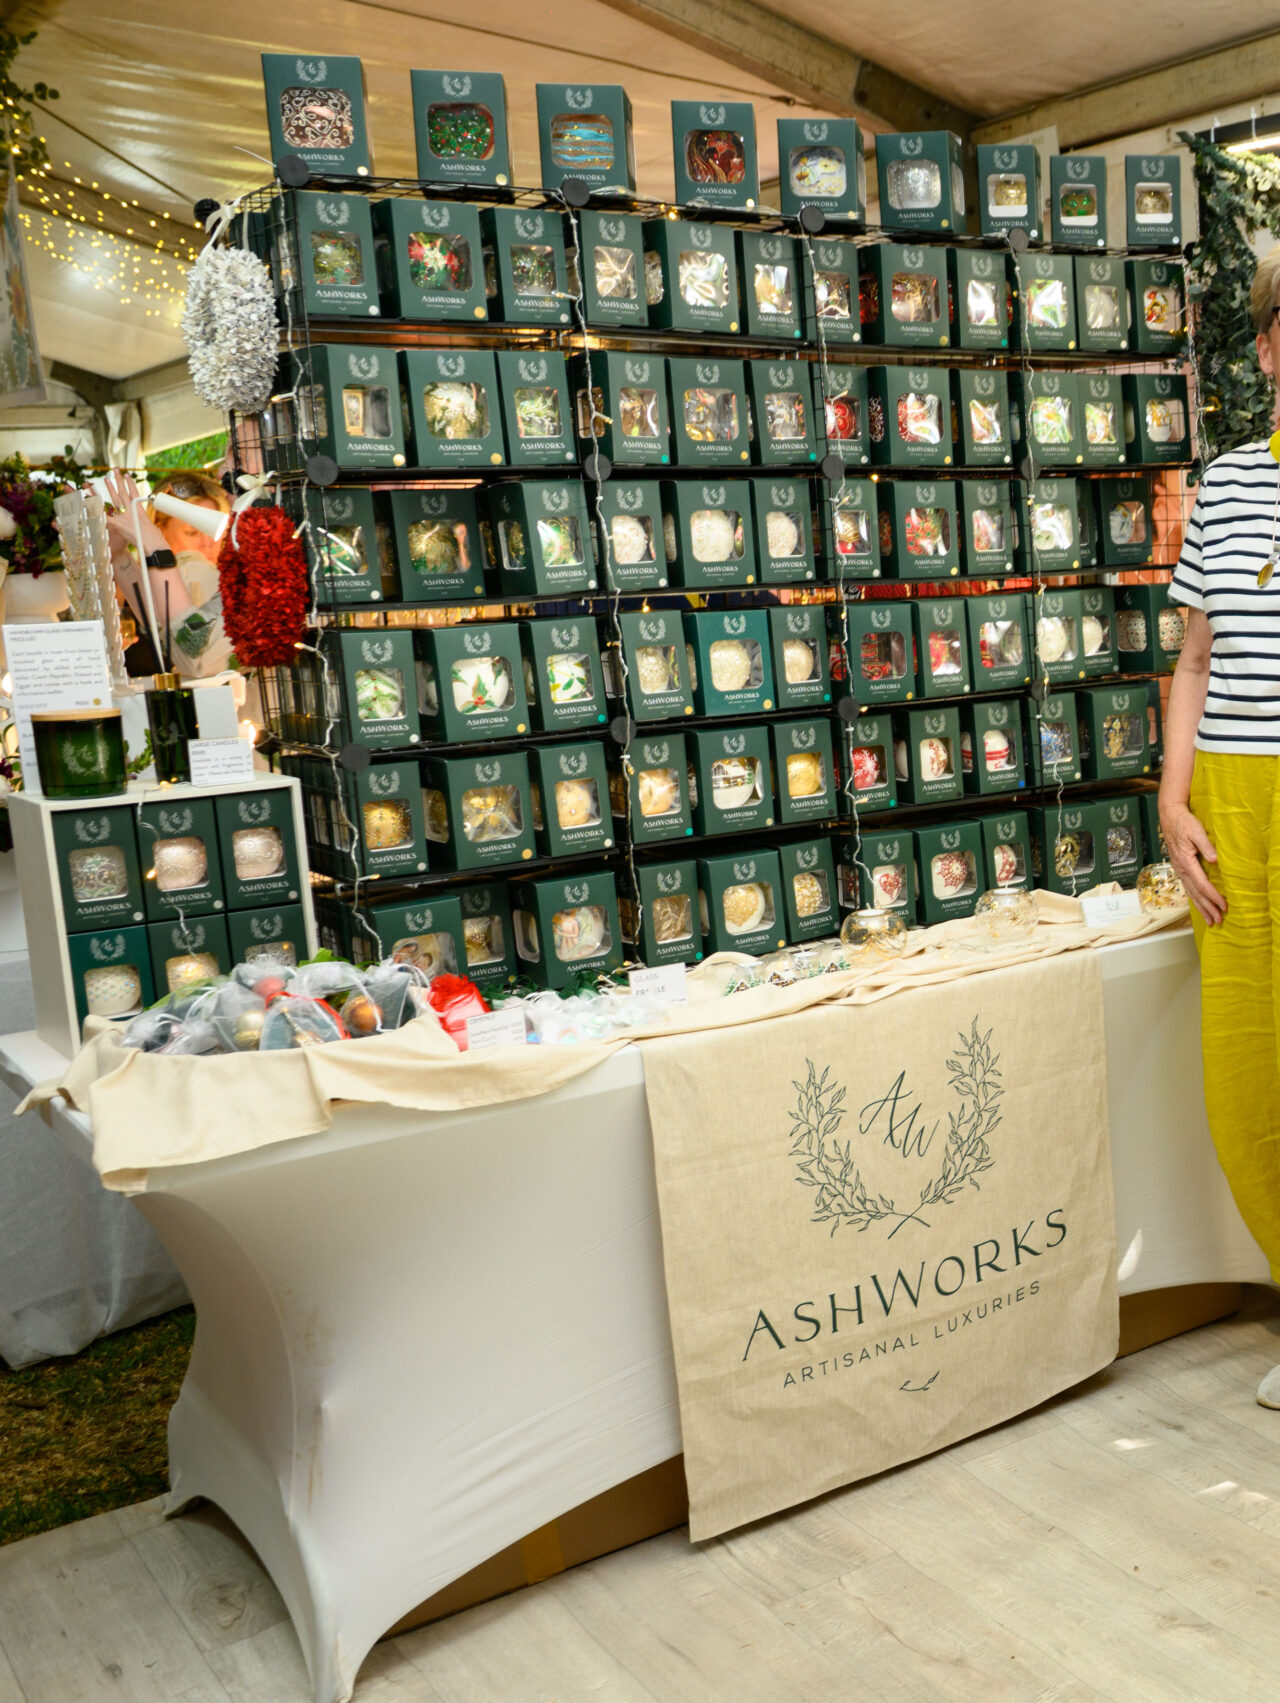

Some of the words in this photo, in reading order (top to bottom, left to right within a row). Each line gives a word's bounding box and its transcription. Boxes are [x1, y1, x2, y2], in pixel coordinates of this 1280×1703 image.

[440, 163, 486, 172] ASHWORKS
[695, 187, 737, 196] ASHWORKS
[315, 289, 367, 299] ASHWORKS
[421, 295, 466, 305] ASHWORKS
[514, 298, 560, 308] ASHWORKS
[596, 300, 639, 309] ASHWORKS
[347, 443, 395, 452] ASHWORKS
[438, 444, 483, 453] ASHWORKS
[520, 442, 565, 451] ASHWORKS
[622, 441, 661, 450] ASHWORKS
[696, 444, 733, 453] ASHWORKS
[702, 565, 739, 574] ASHWORKS
[770, 561, 807, 569] ASHWORKS
[546, 569, 587, 579] ASHWORKS
[617, 566, 658, 576] ASHWORKS
[422, 578, 464, 587] ASHWORKS
[643, 696, 684, 706] ASHWORKS
[553, 705, 598, 716] ASHWORKS
[465, 715, 508, 725] ASHWORKS
[360, 724, 409, 733] ASHWORKS
[790, 799, 828, 808] ASHWORKS
[723, 811, 759, 820] ASHWORKS
[643, 817, 683, 828] ASHWORKS
[561, 829, 604, 841] ASHWORKS
[476, 842, 517, 854] ASHWORKS
[368, 853, 416, 864] ASHWORKS
[238, 881, 289, 893] ASHWORKS
[76, 903, 131, 914] ASHWORKS
[798, 916, 833, 927] ASHWORKS
[656, 944, 694, 954] ASHWORKS
[467, 966, 505, 977] SHWORKS
[742, 1208, 1068, 1362] ASHWORKS
[782, 1336, 920, 1389] ARTISANAL
[934, 1280, 1041, 1340] LUXURIES
